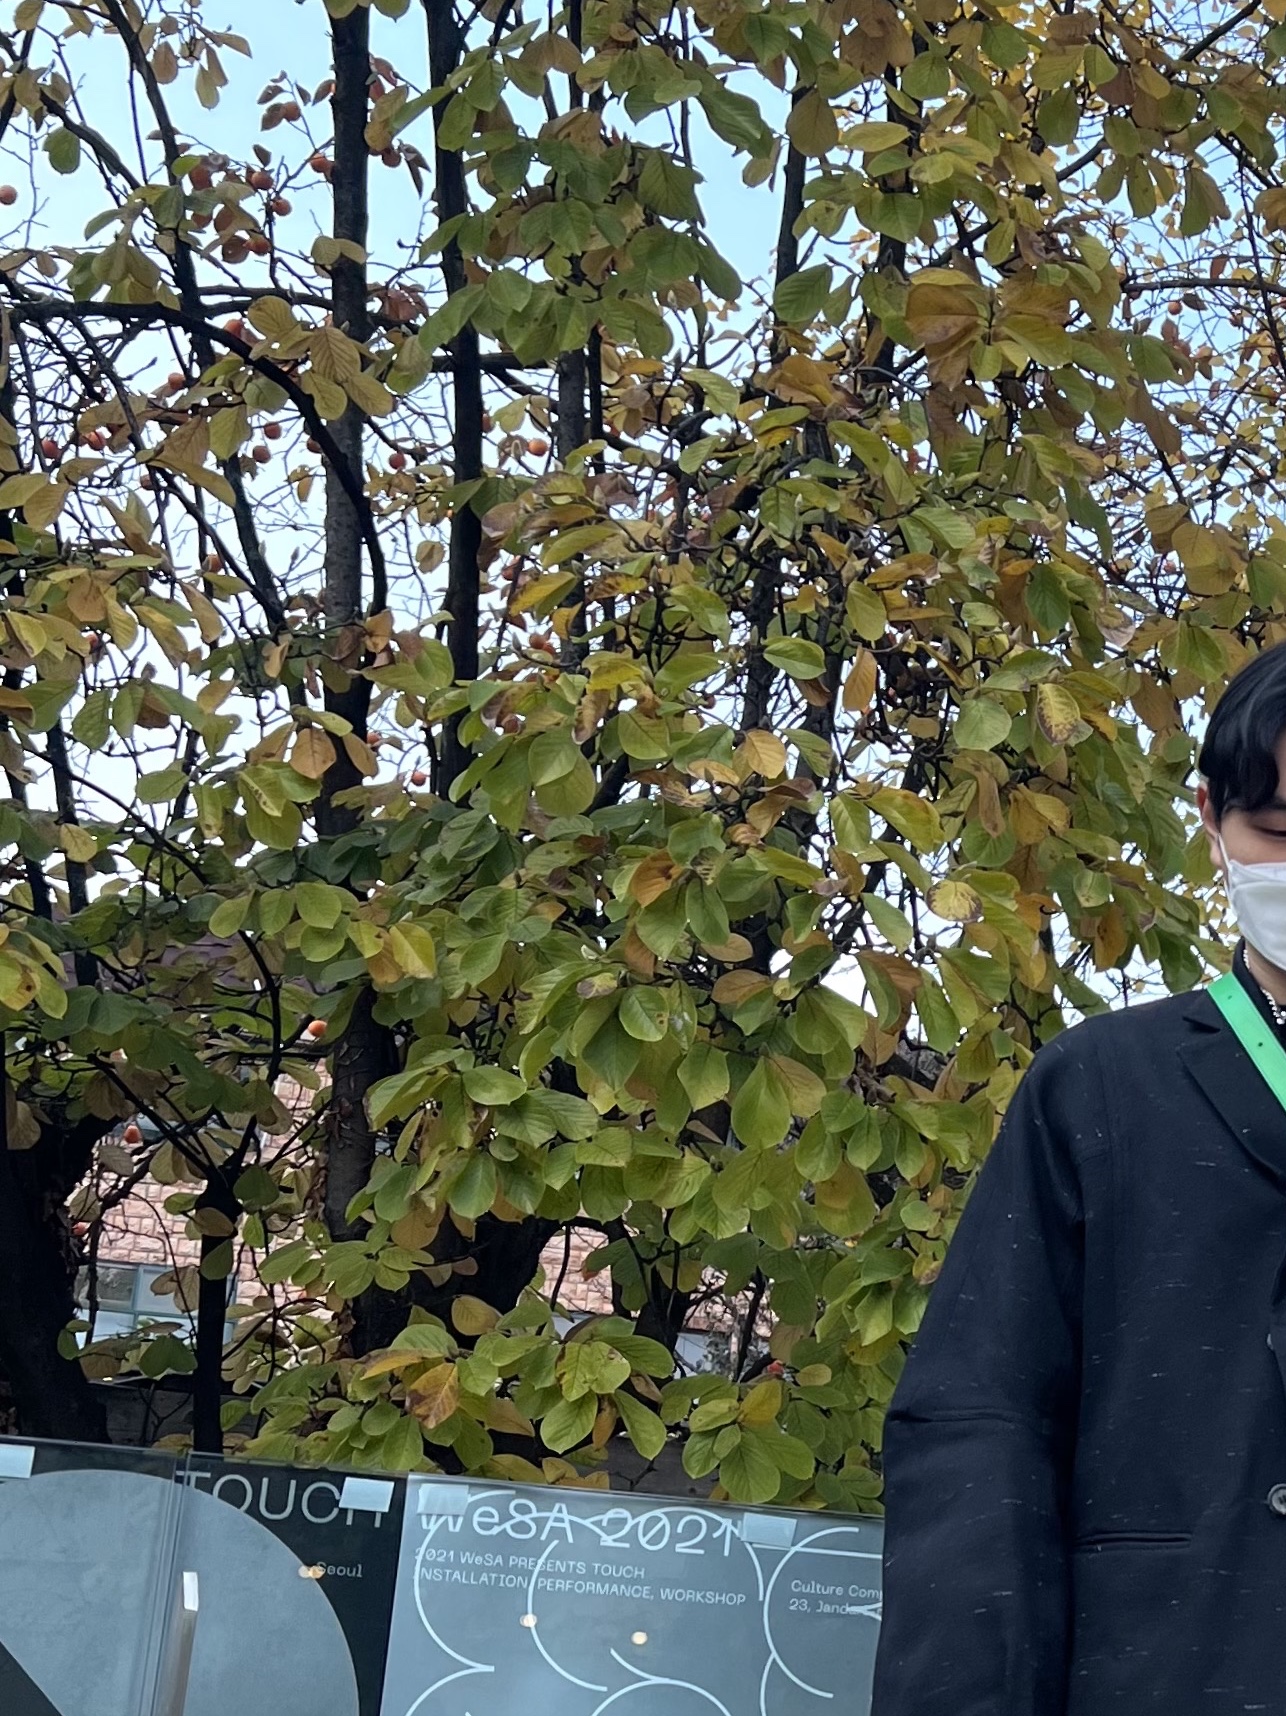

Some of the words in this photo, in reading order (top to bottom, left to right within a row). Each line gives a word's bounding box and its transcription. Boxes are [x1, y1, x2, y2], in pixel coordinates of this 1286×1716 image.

[599, 1508, 733, 1557] 2021
[460, 1551, 503, 1567] WeSA
[592, 1563, 645, 1579] TOUCH
[537, 1578, 654, 1600] PERFORMANCE,
[660, 1588, 746, 1606] WORKSHOP
[791, 1580, 844, 1595] Culture
[848, 1585, 882, 1601] Com
[789, 1598, 811, 1613] 23,
